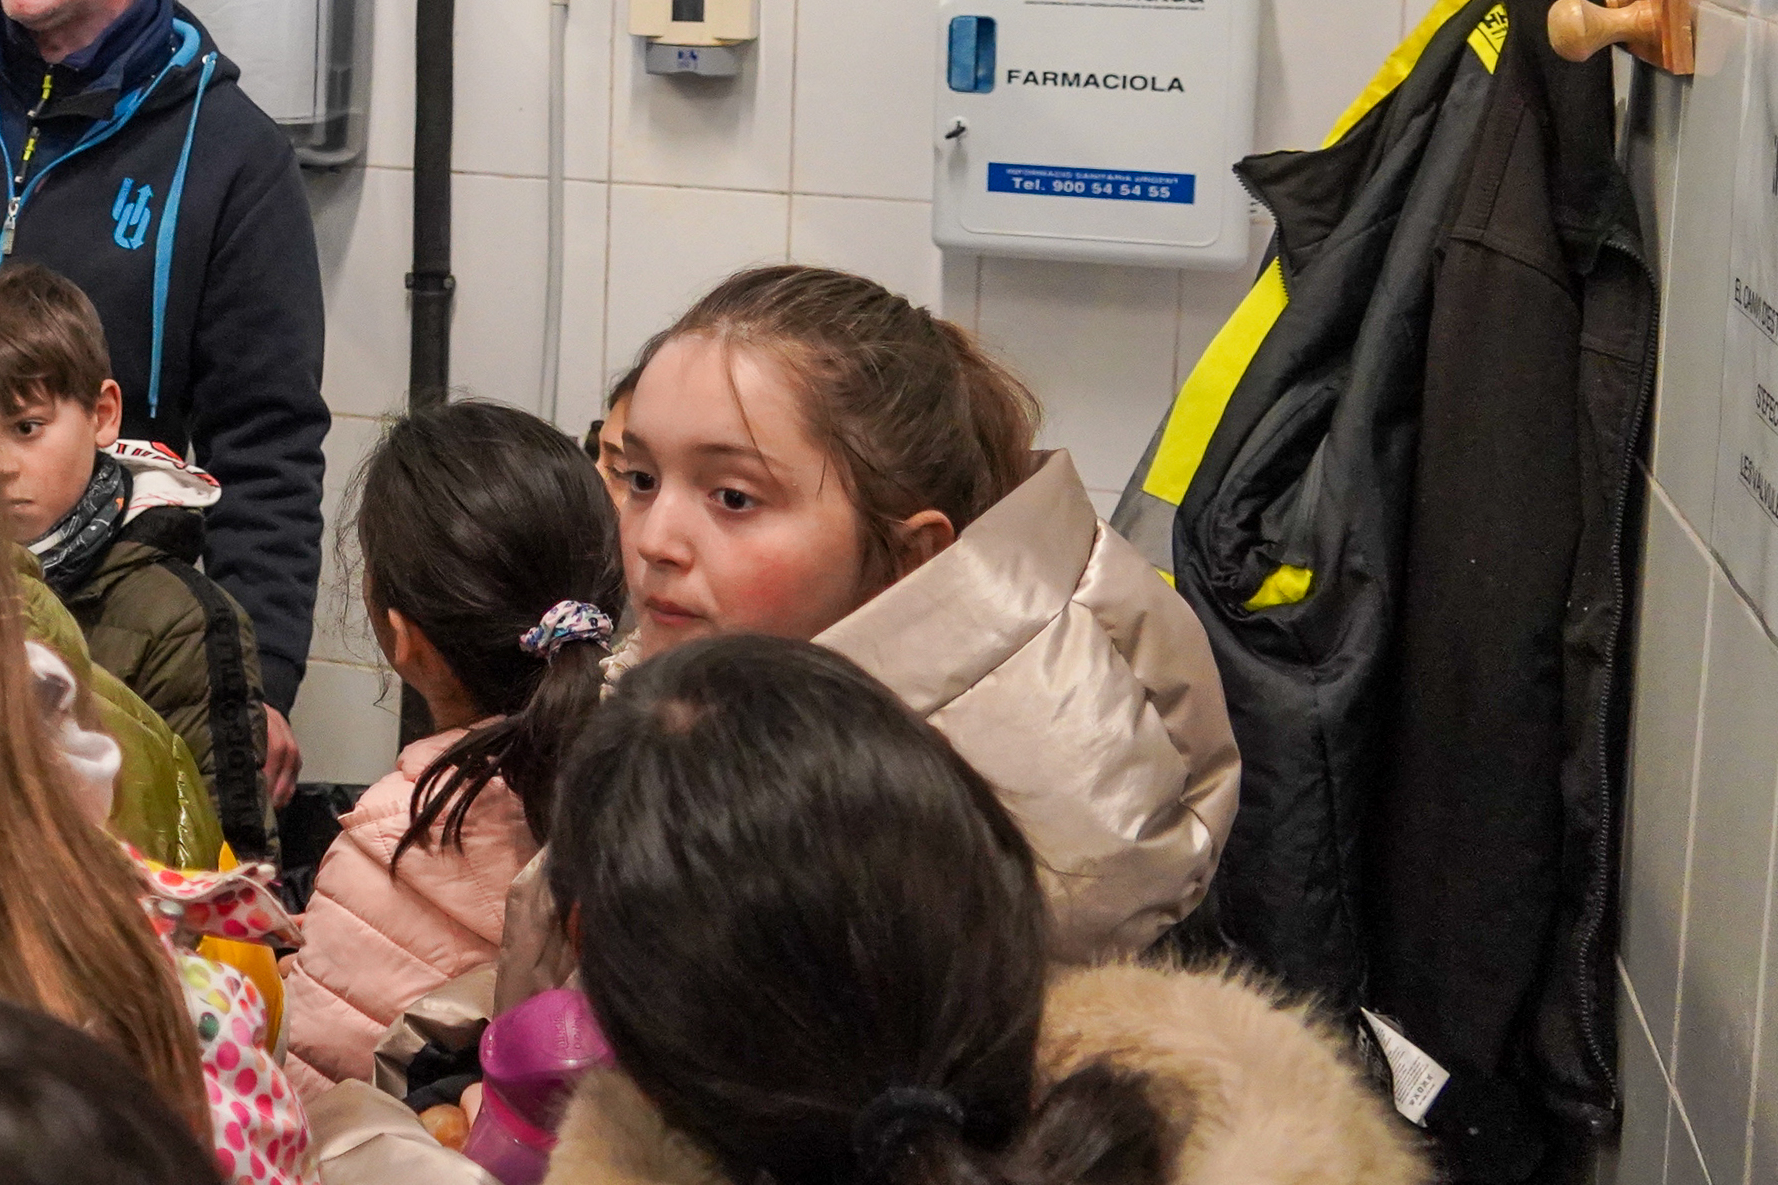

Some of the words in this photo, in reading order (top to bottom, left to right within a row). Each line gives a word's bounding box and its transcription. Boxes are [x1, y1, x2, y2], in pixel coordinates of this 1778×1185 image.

[1007, 69, 1185, 92] FARMACIOLA
[1012, 177, 1046, 191] Tel.
[1052, 180, 1086, 193] 900
[1091, 182, 1113, 195] 54
[1119, 184, 1141, 197] 54
[1148, 185, 1170, 199] 55
